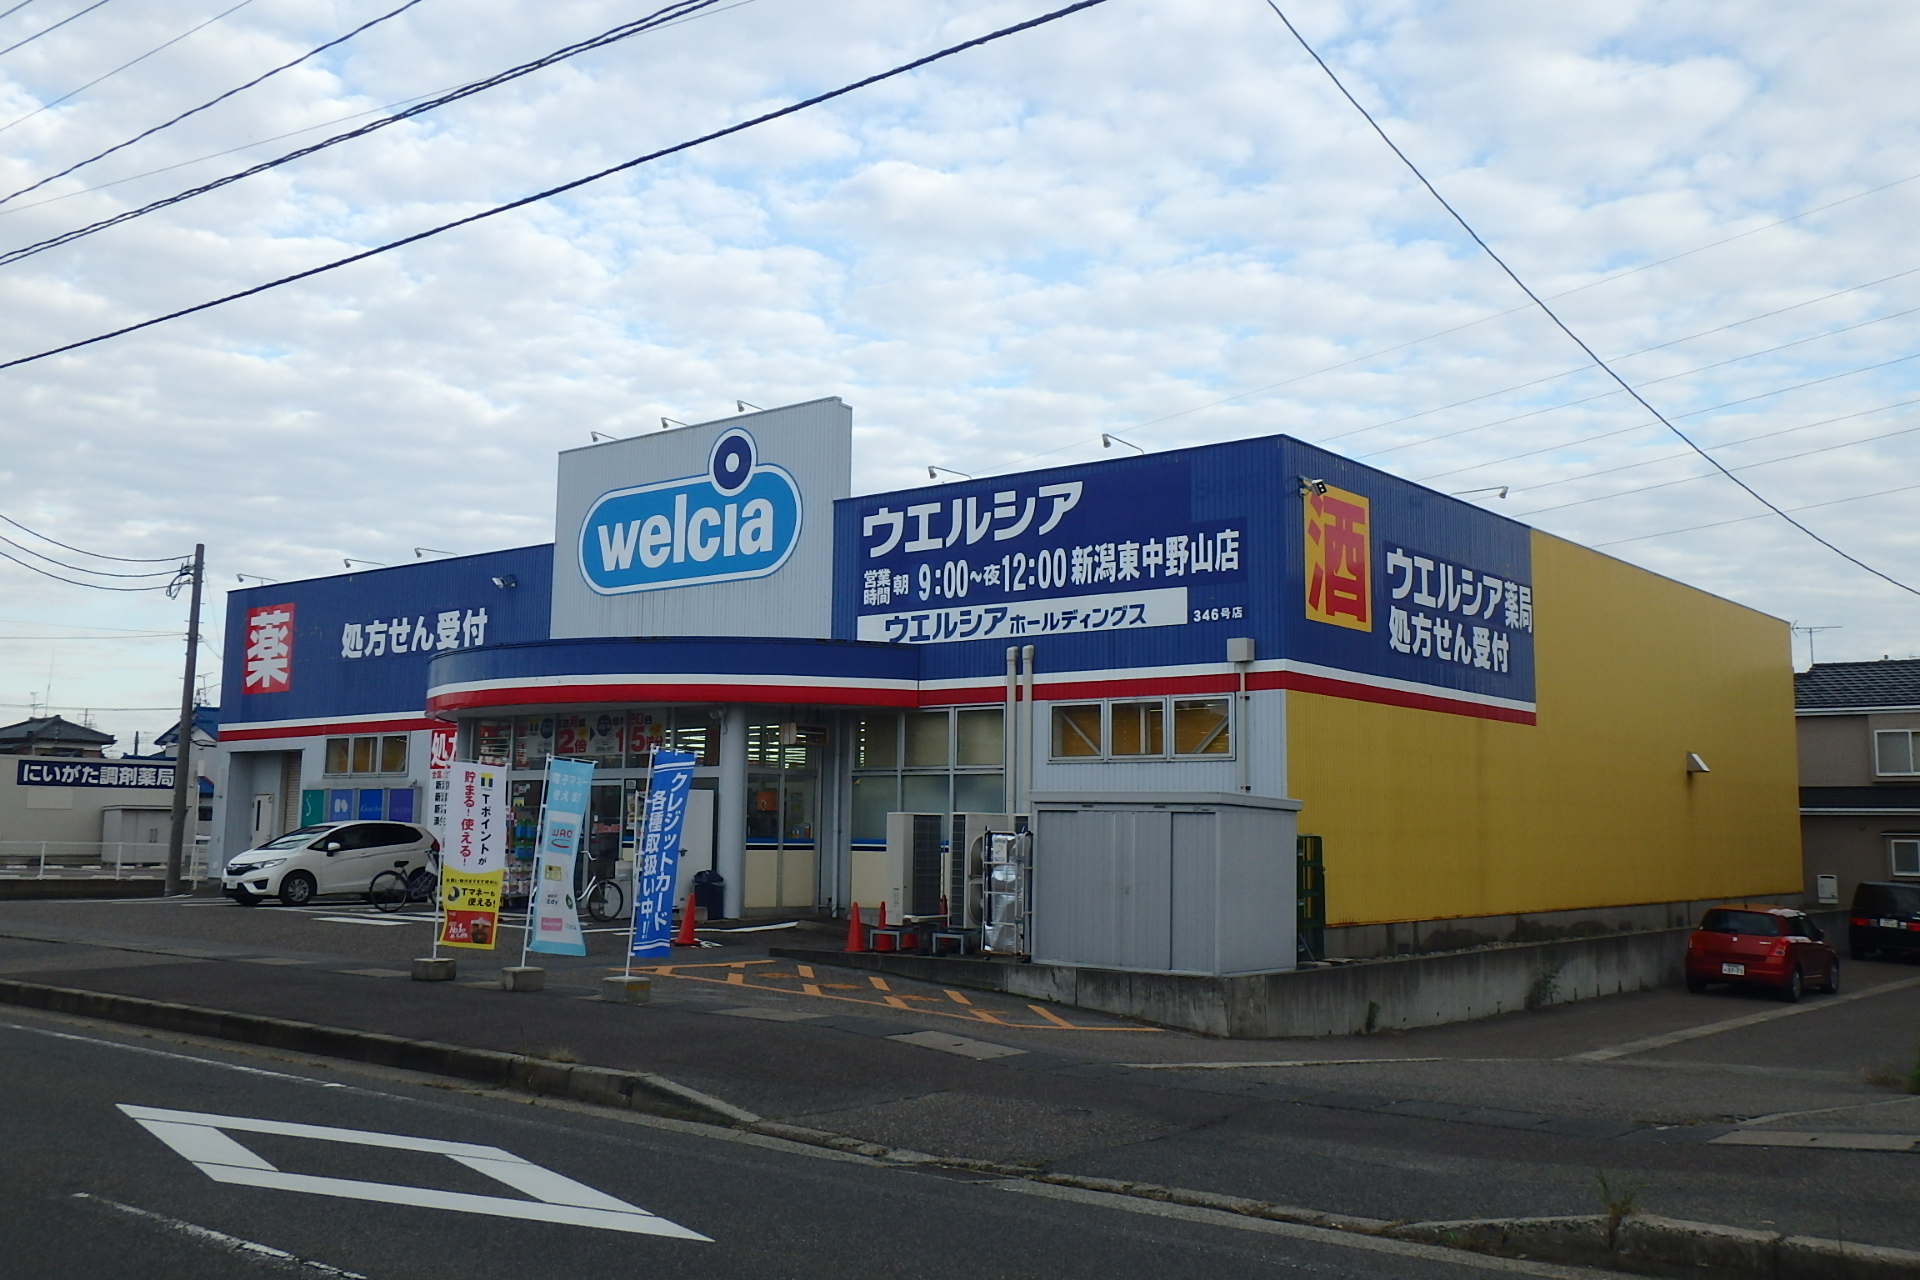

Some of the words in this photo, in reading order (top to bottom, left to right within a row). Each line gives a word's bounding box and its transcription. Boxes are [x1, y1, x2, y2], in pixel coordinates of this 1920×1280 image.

[597, 493, 774, 572] welcia
[863, 481, 1083, 558] ウエルシア
[863, 569, 891, 589] 営業
[893, 574, 910, 595] 朝
[1071, 529, 1241, 586] 新潟東中野山店
[1308, 494, 1367, 623] 酒
[863, 588, 891, 606] 時間
[1193, 607, 1243, 623] 346号店
[1386, 548, 1533, 634] ウエルシア薬局
[246, 610, 291, 688] 薬
[341, 607, 488, 659] 処方せん受付
[1389, 605, 1510, 673] 処方せん受付
[23, 764, 175, 787] にいがた調剤薬局
[654, 772, 688, 931] クレジットカード
